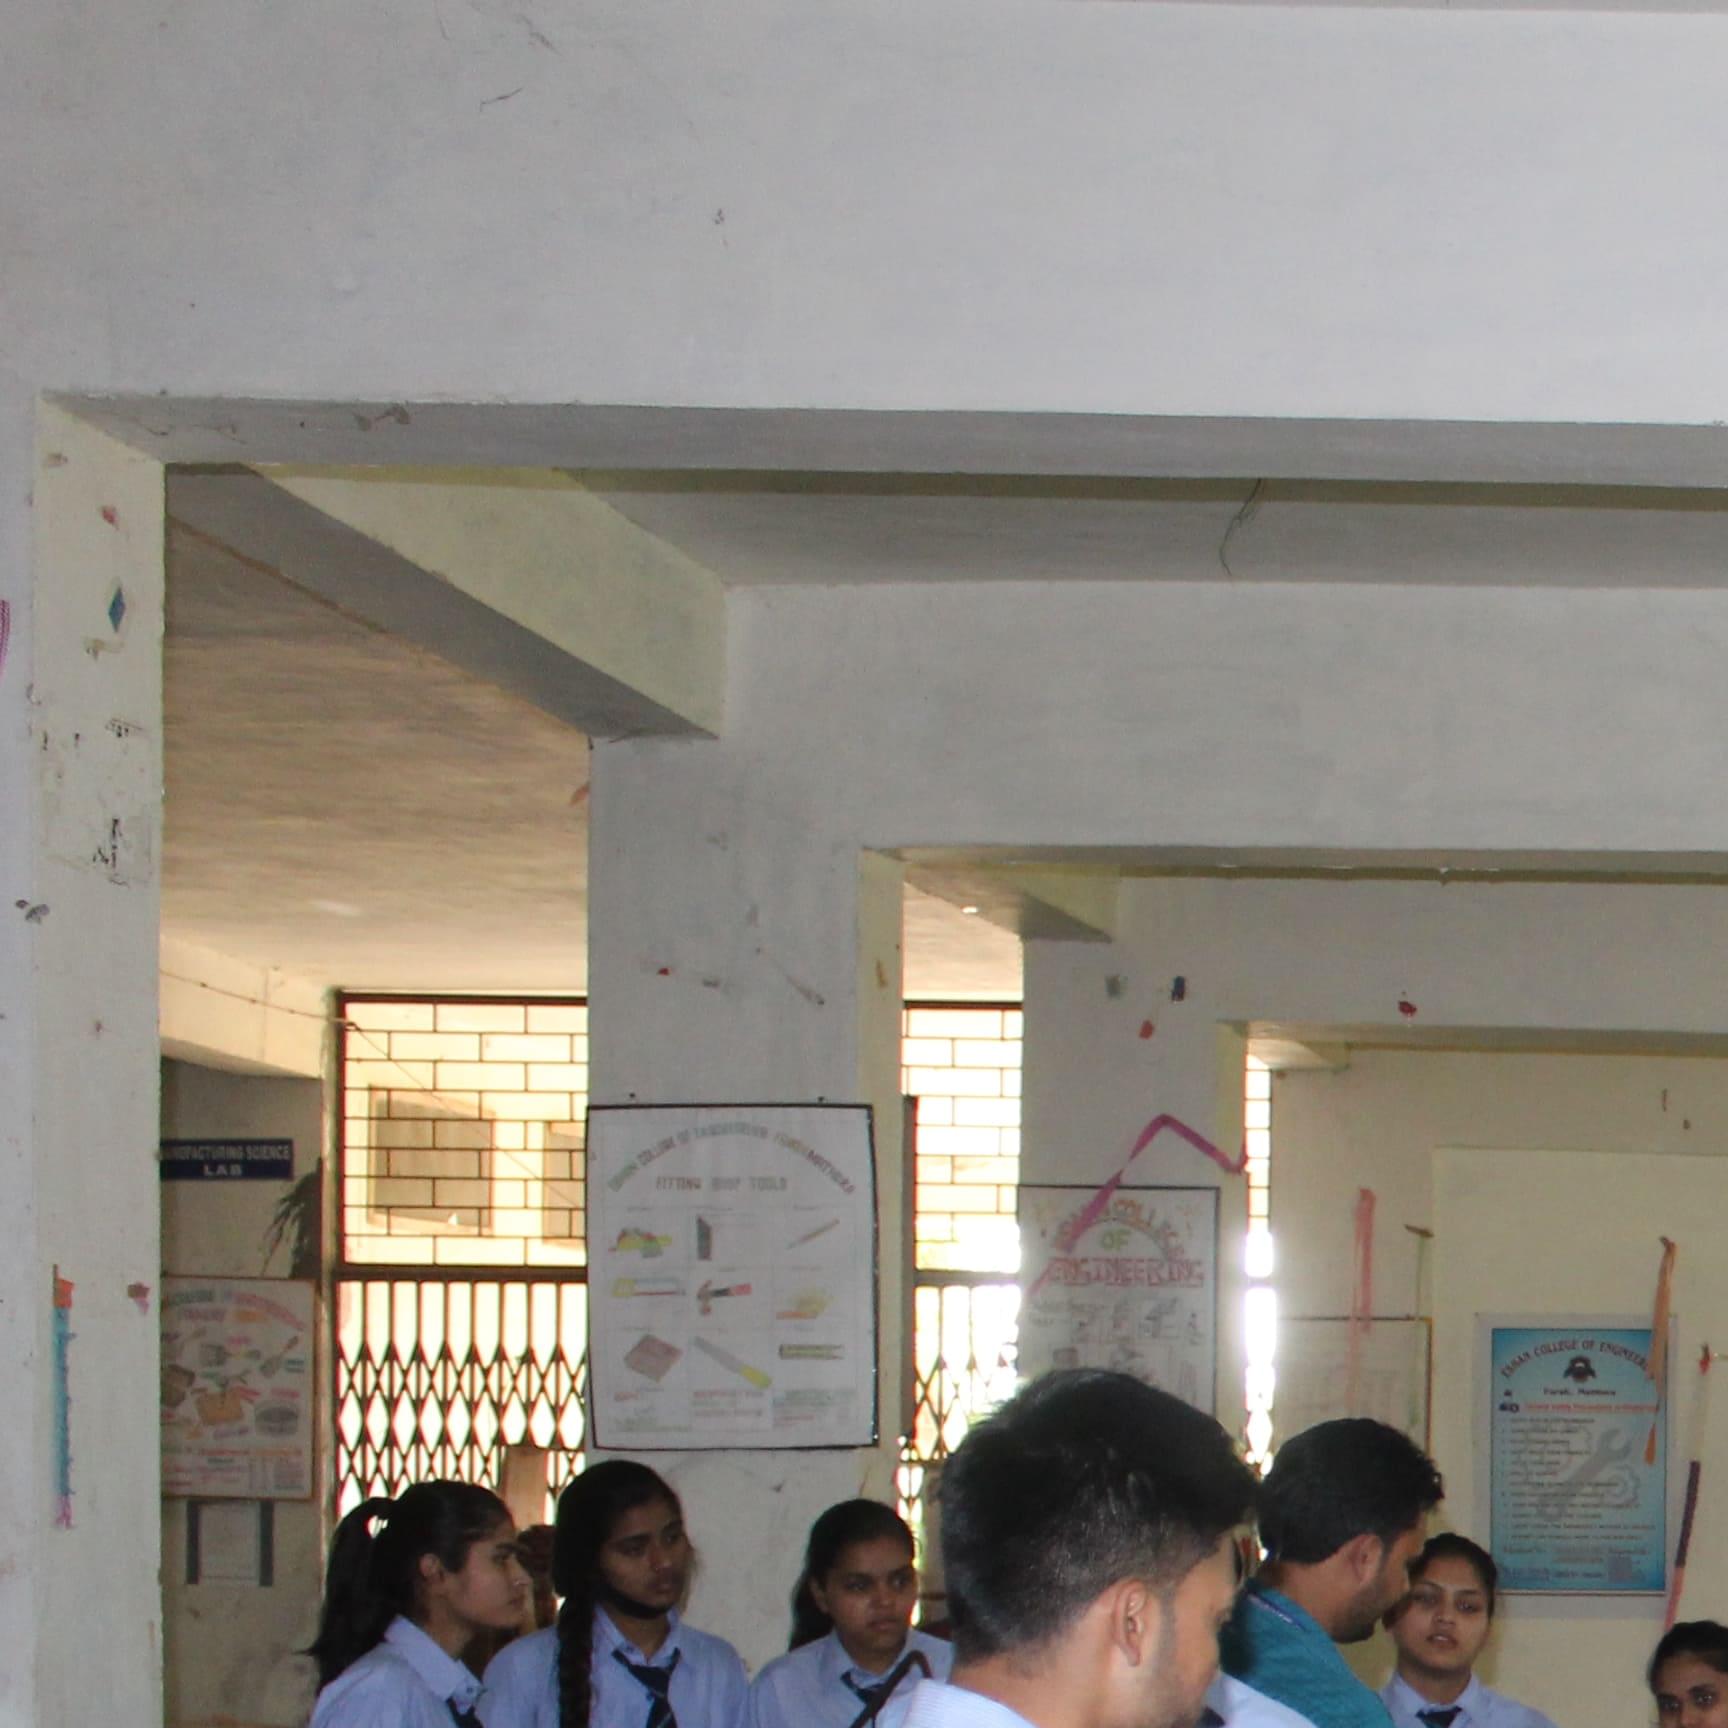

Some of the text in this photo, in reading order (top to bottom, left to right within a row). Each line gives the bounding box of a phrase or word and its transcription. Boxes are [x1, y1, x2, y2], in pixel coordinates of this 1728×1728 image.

[203, 1164, 242, 1177] LAB
[1534, 1338, 1578, 1357] COLLEGE
[1581, 1339, 1595, 1350] OF
